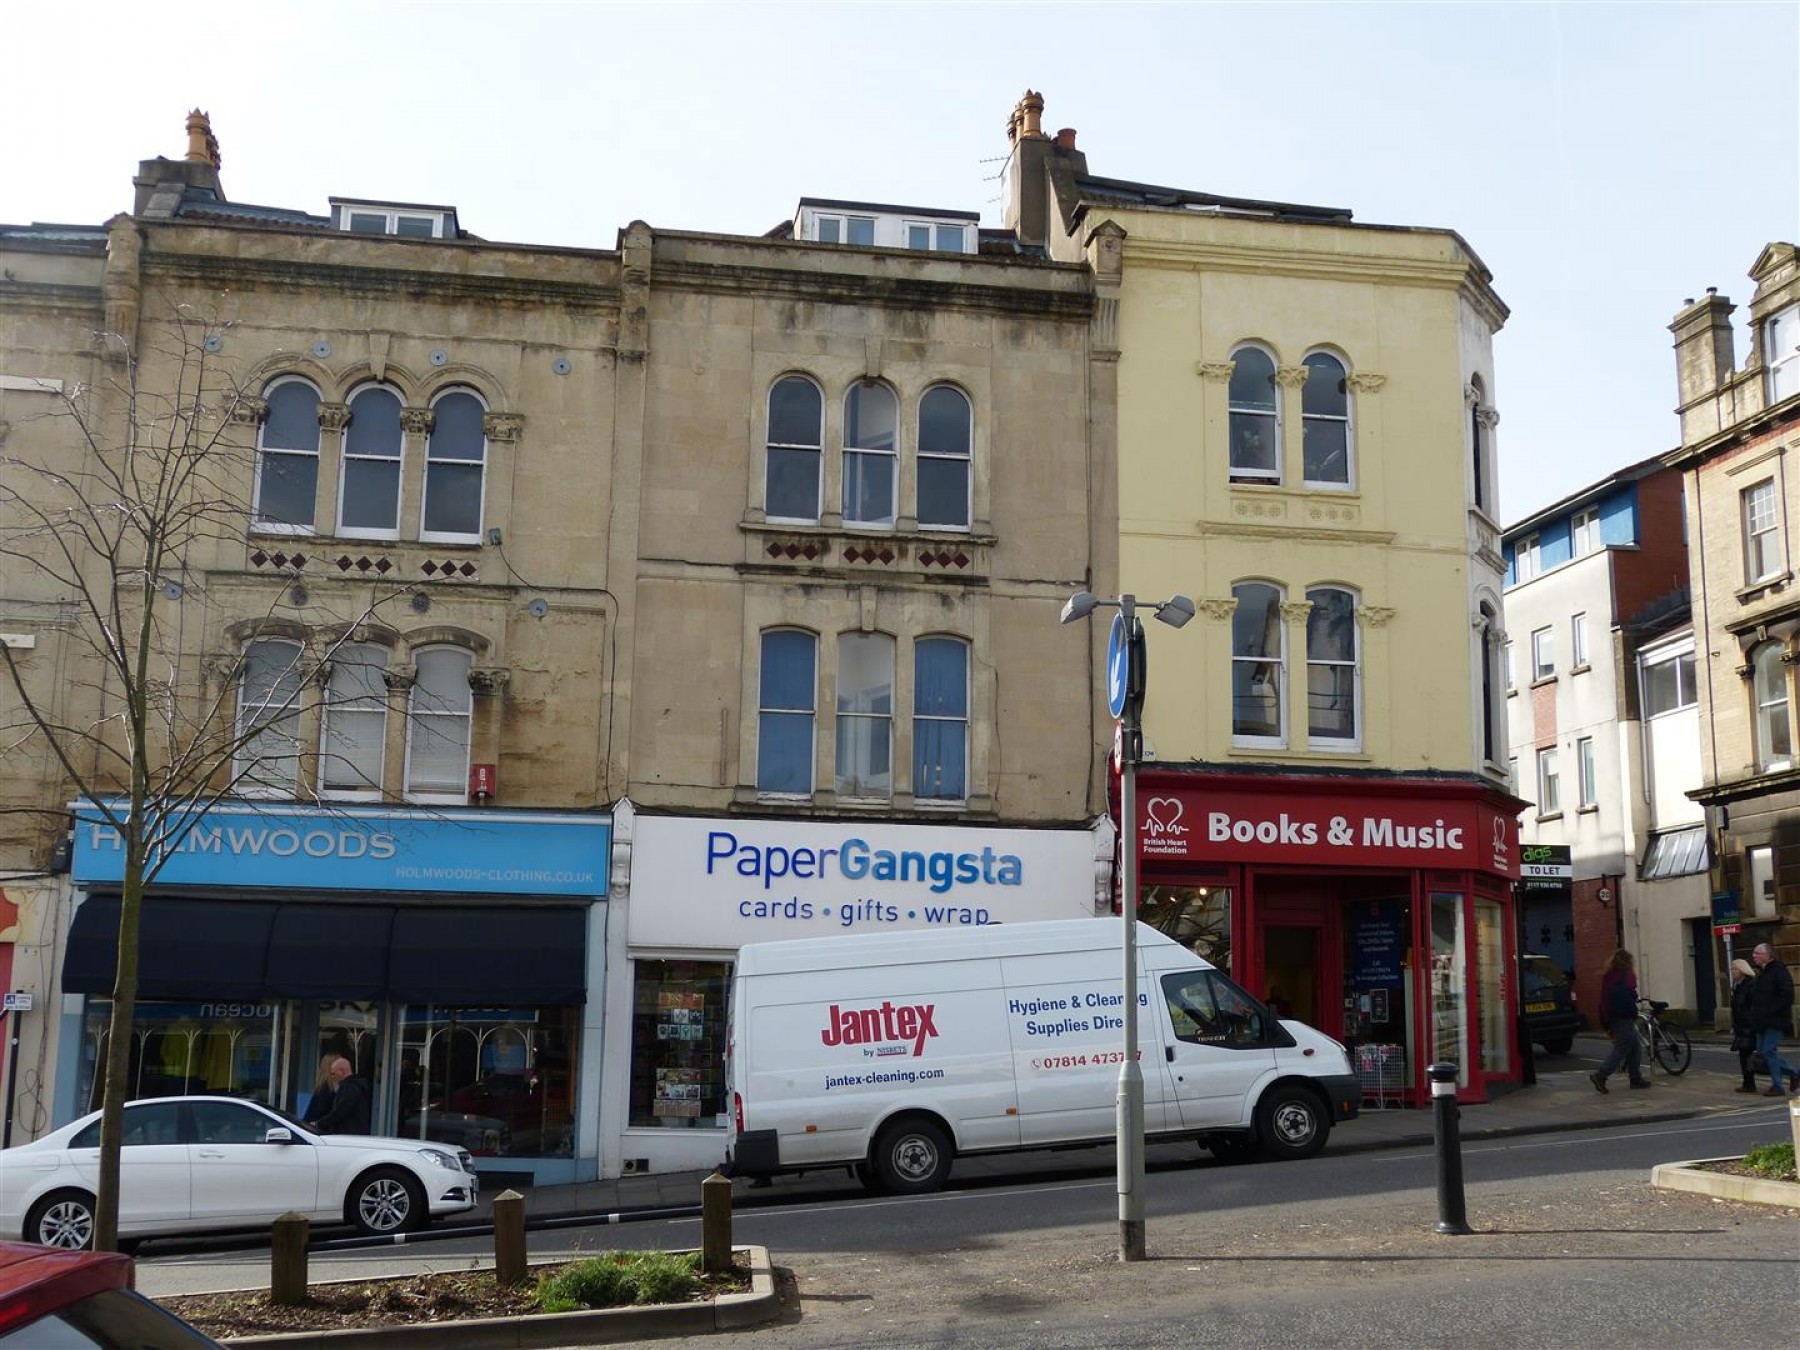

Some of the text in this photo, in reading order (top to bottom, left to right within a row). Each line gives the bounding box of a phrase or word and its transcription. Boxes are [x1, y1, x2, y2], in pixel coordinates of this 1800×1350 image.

[1208, 811, 1464, 850] Books & Music
[91, 823, 396, 858] HLMWOODS
[1143, 838, 1166, 846] British
[1143, 846, 1188, 854] Foundation
[706, 831, 1023, 893] PaperGangsta
[1523, 846, 1552, 863] digs
[395, 867, 594, 883] HOLMWOODS-CLOTHING.CO.UK
[1529, 866, 1561, 875] TO LET
[739, 897, 989, 926] cards gifts wrap
[1009, 998, 1067, 1015] Hygiene
[1071, 995, 1081, 1008] &
[821, 1001, 940, 1057] Jantex
[1026, 1018, 1089, 1037] Supplies
[863, 1048, 874, 1058] by
[1043, 1050, 1143, 1069] 07814 47377
[825, 1069, 945, 1090] jantex-cleaning.com
